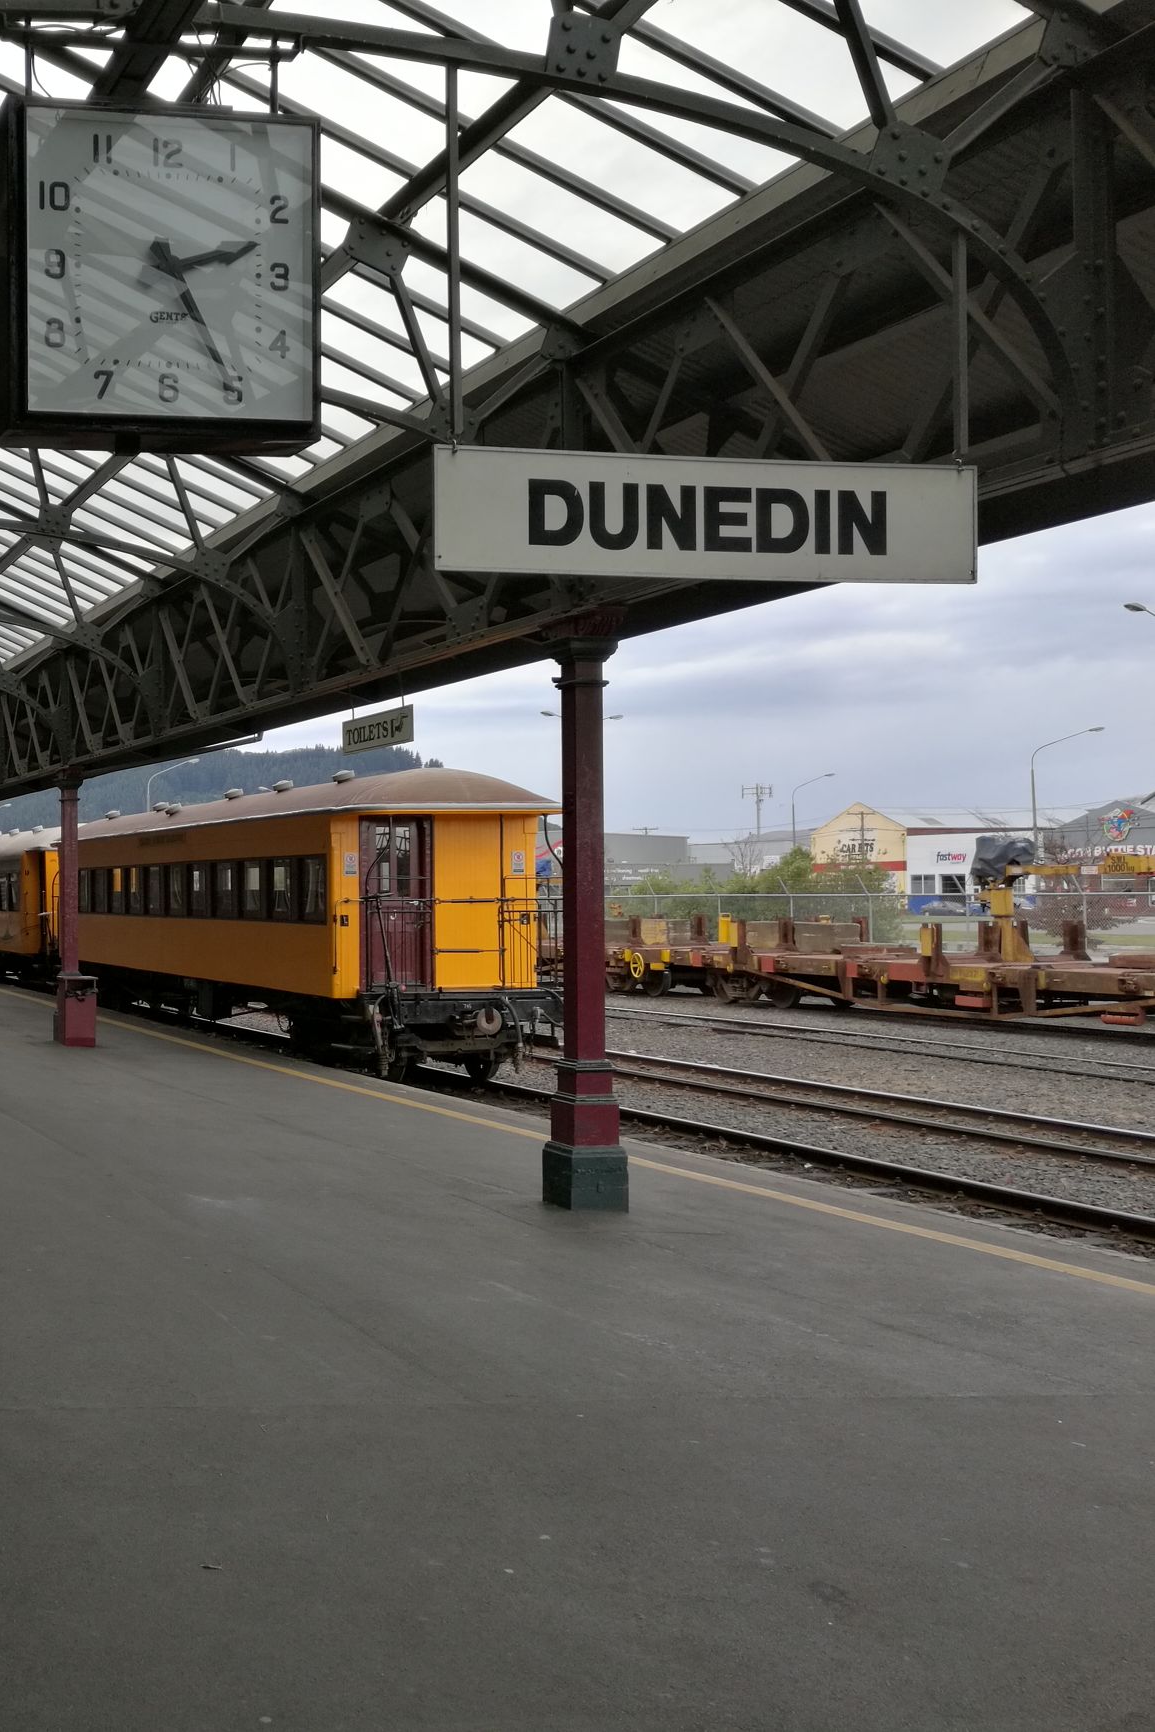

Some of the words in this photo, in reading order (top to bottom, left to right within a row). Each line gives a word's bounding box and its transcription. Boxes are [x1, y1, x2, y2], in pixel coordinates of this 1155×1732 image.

[93, 133, 112, 164] 11
[152, 137, 182, 168] 12
[230, 142, 236, 172] 1
[39, 180, 70, 211] 10
[270, 195, 289, 225] 2
[44, 248, 66, 280] 9
[270, 262, 289, 292] 3
[45, 317, 66, 349] 8
[269, 329, 290, 359] 4
[93, 369, 114, 400] 7
[158, 373, 180, 403] 6
[222, 375, 243, 404] 5
[527, 478, 888, 556] DUNEDIN
[346, 720, 389, 746] TOILETS
[936, 851, 967, 863] fastway
